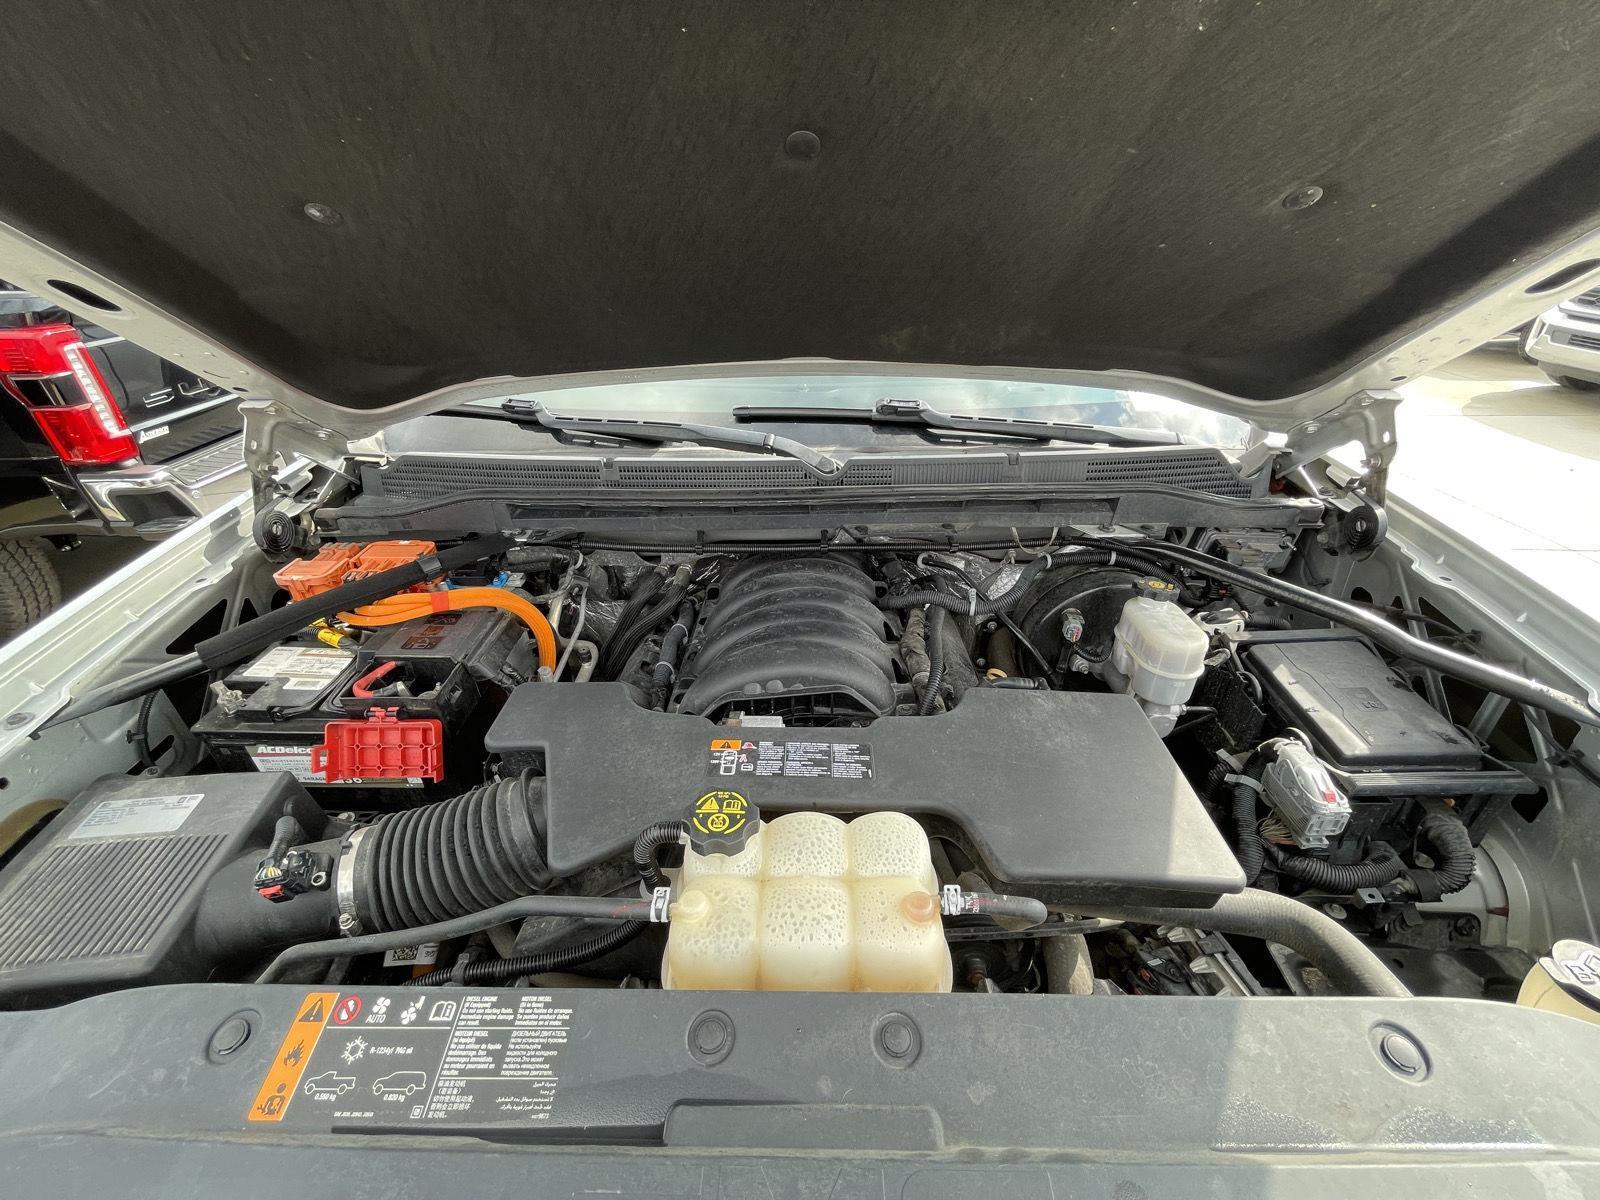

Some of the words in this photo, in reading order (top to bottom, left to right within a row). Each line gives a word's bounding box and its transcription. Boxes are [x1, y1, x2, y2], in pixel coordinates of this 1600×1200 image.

[366, 1014, 386, 1024] AUTO
[330, 1092, 337, 1102] kg
[398, 1093, 406, 1102] kg
